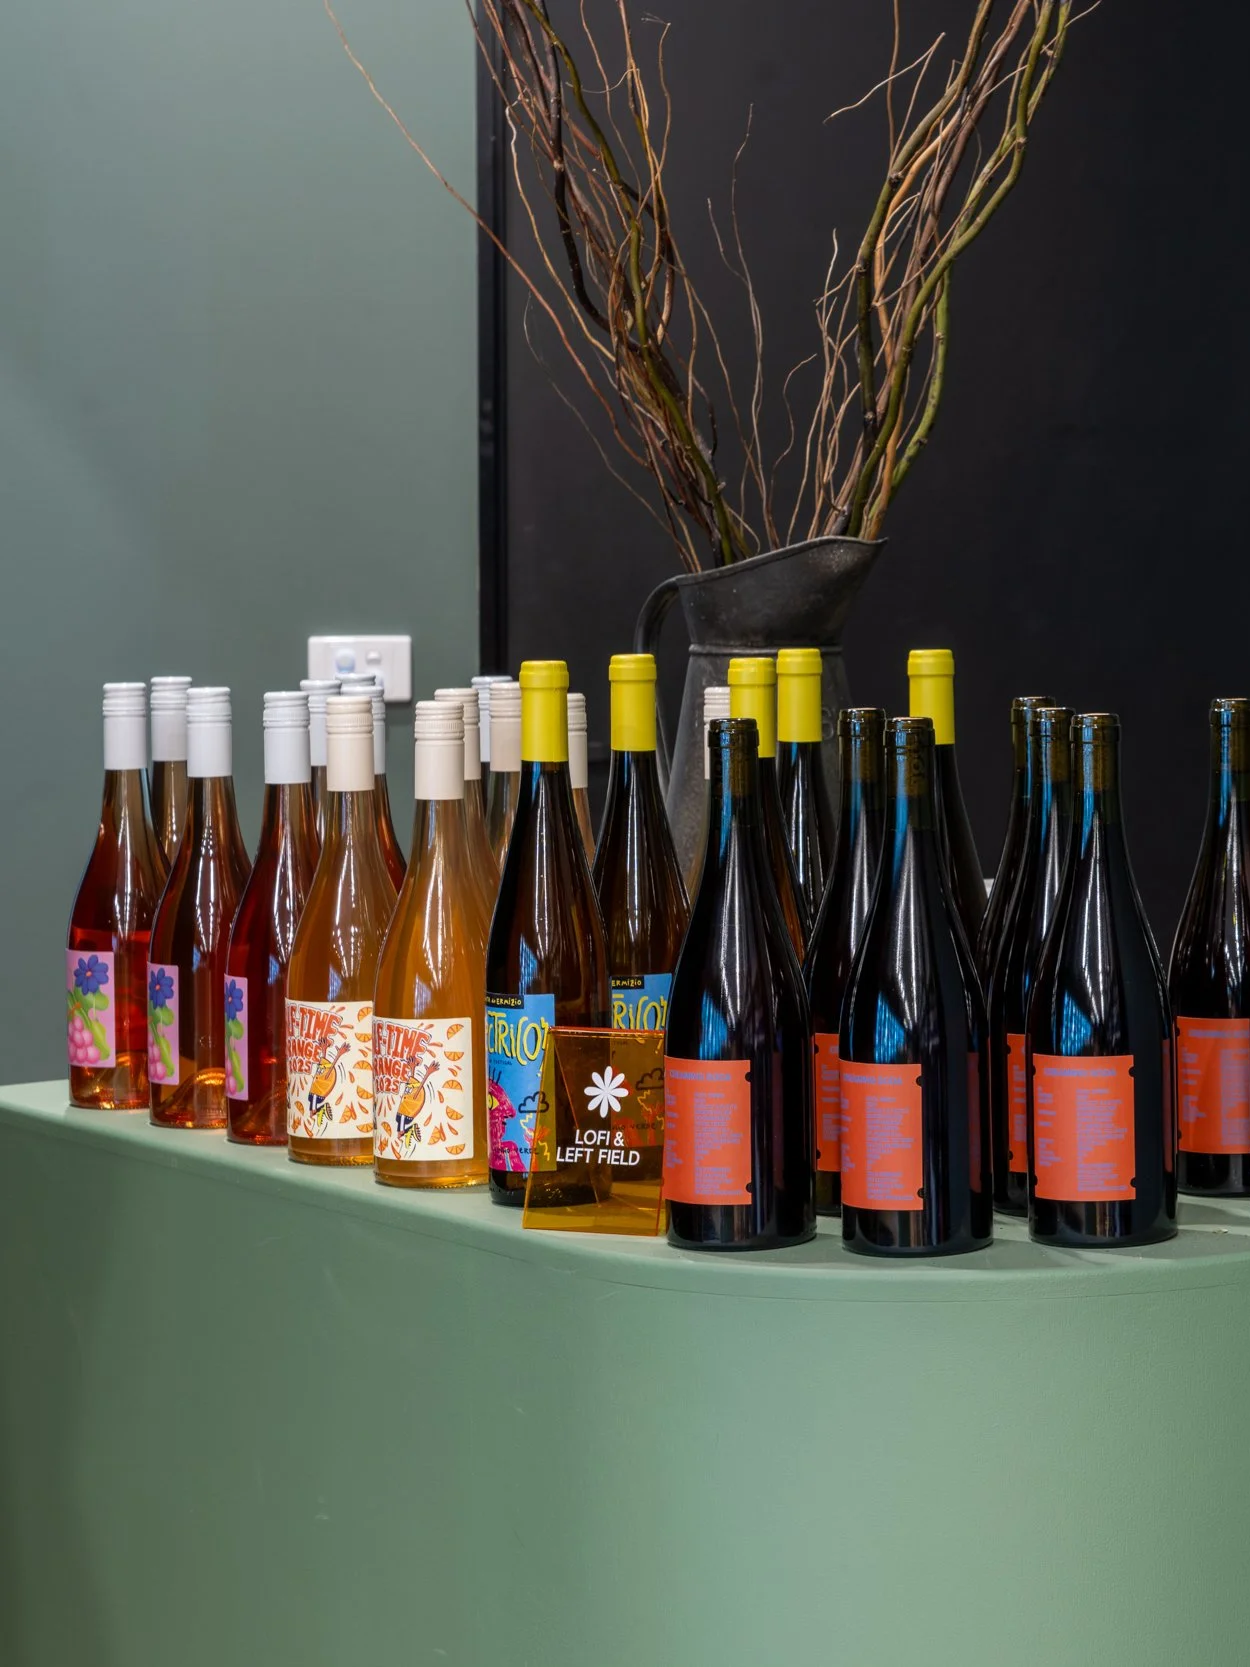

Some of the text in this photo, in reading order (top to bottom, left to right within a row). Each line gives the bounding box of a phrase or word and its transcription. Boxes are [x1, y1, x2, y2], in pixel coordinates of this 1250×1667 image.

[575, 1129, 625, 1147] LOFI &
[556, 1147, 640, 1166] LEFT FIELD
